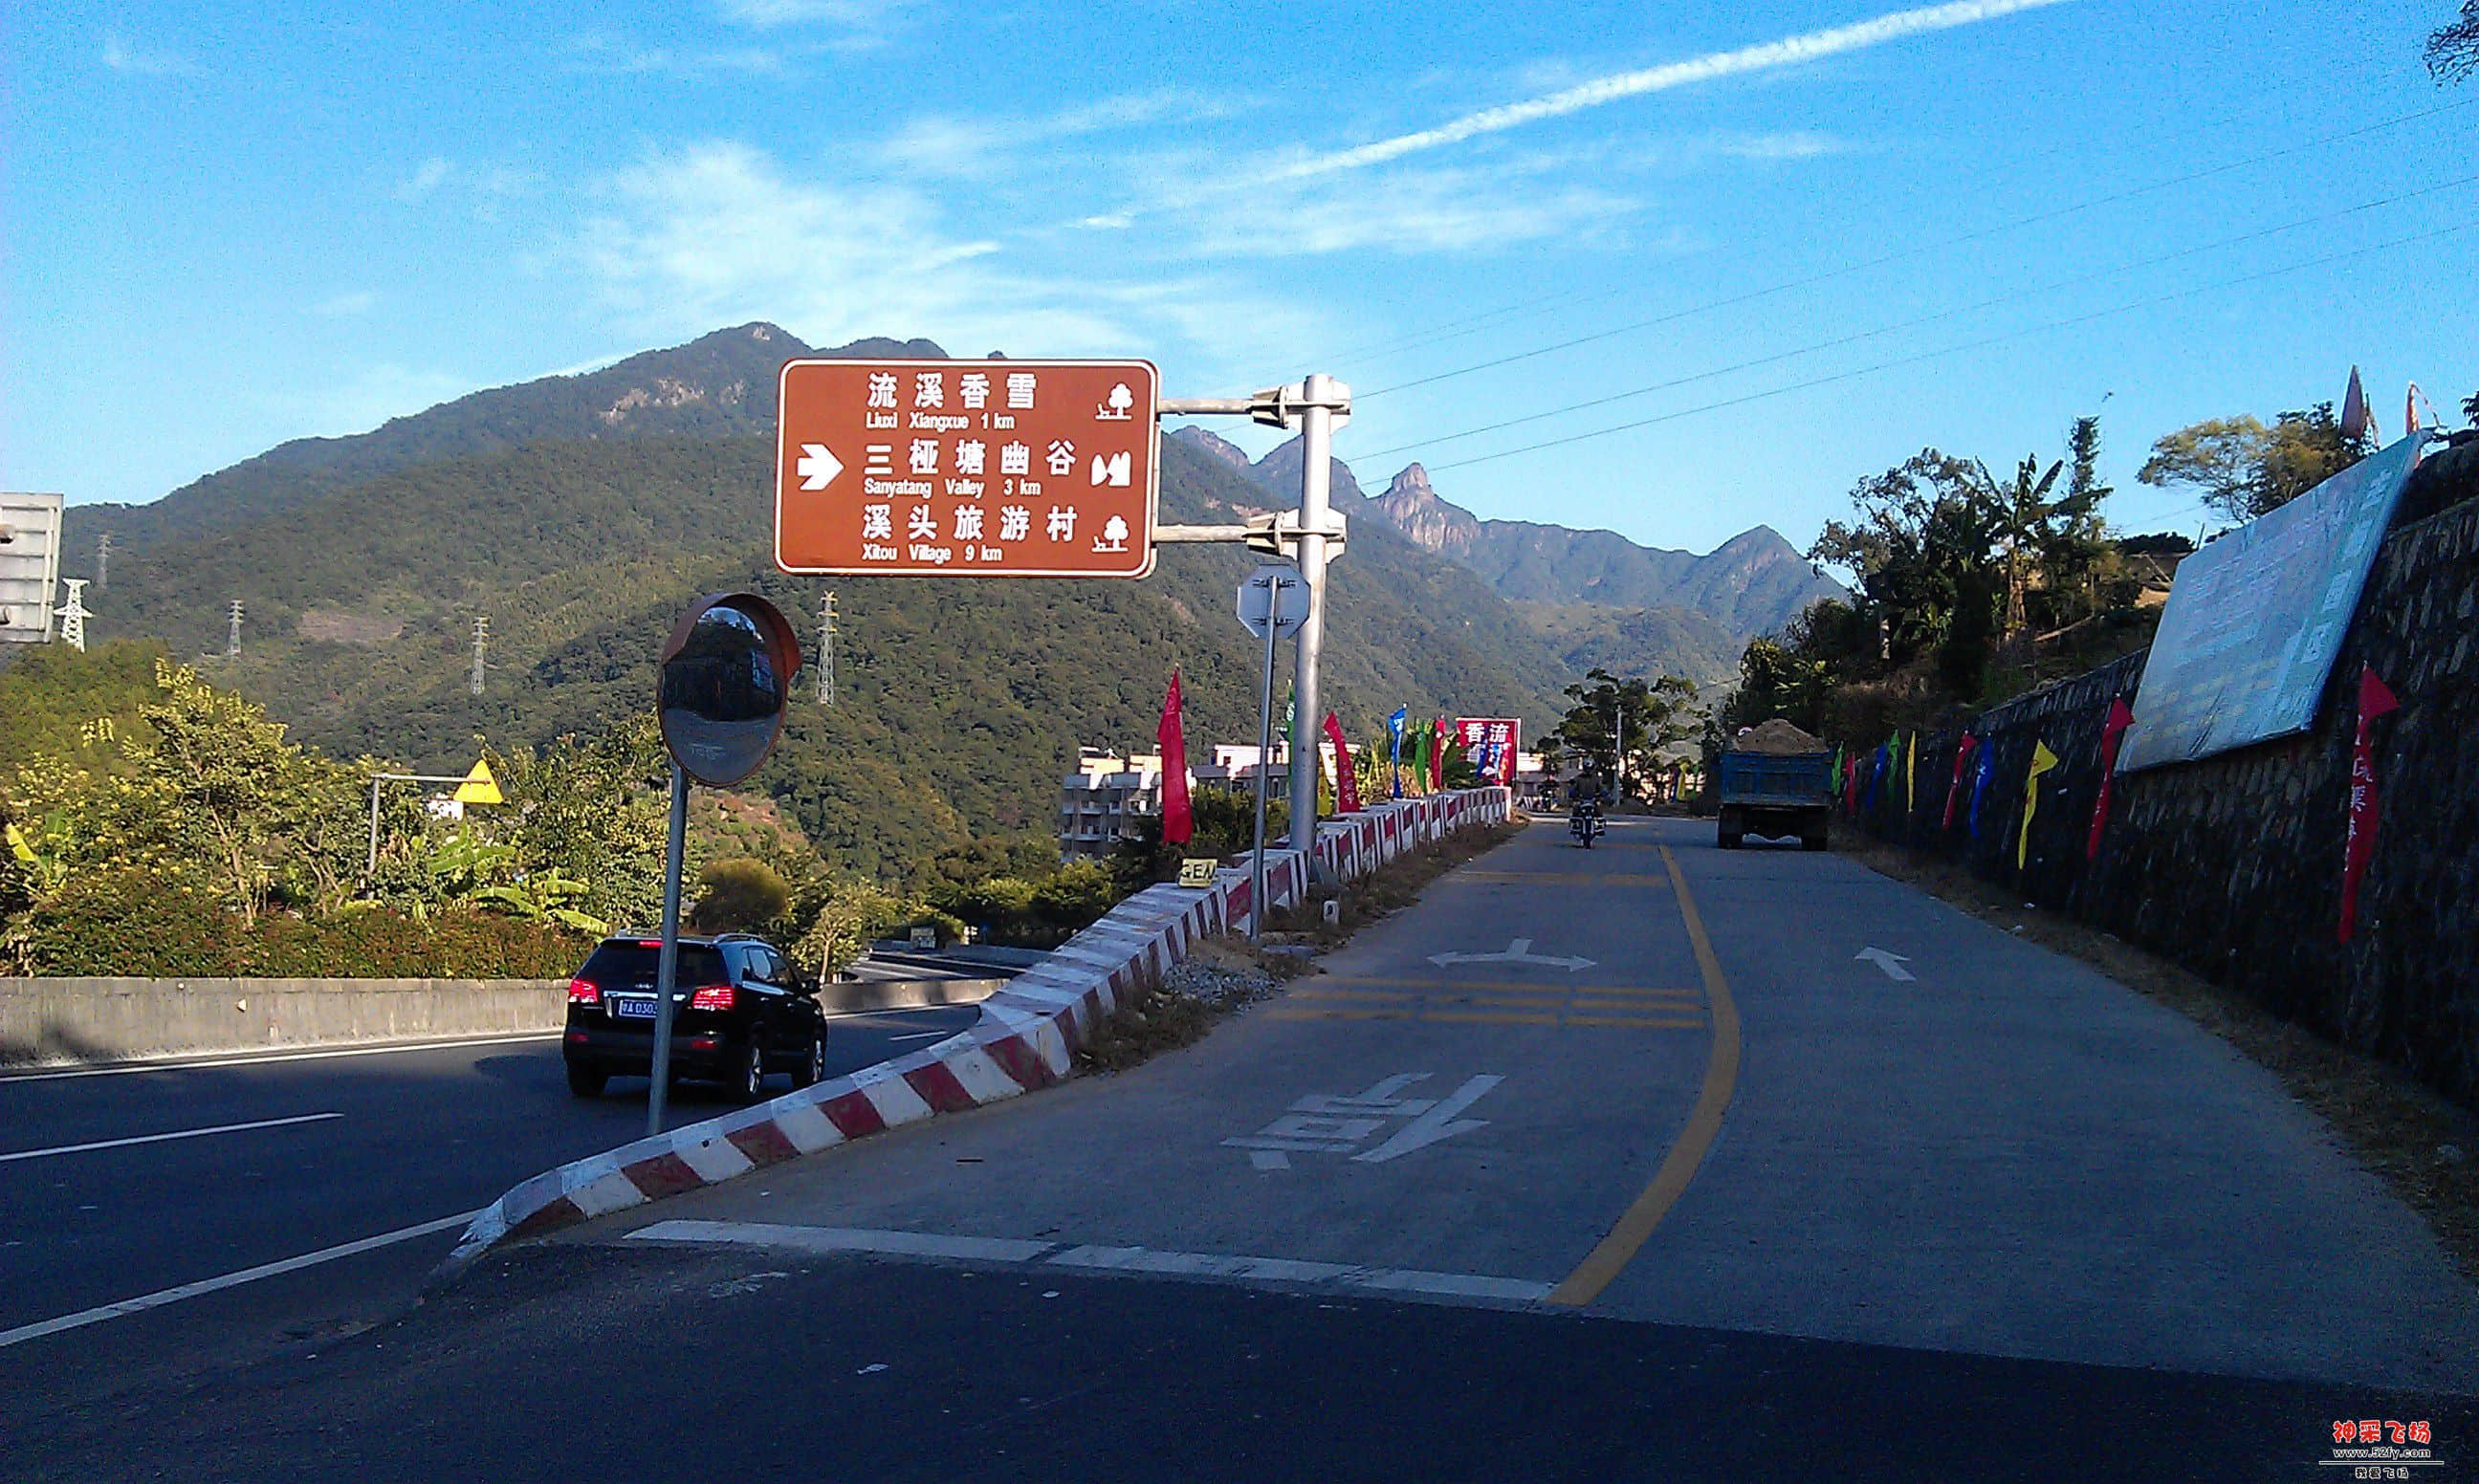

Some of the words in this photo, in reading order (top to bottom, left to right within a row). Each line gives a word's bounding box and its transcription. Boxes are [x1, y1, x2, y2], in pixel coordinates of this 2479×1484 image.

[867, 372, 1036, 408] 流溪香雪
[867, 412, 897, 428] Liuxi
[910, 412, 969, 432] Xiangxue
[981, 413, 988, 428] 1
[994, 413, 1014, 428] km
[865, 439, 1076, 474] 三桠塘幽谷
[865, 478, 932, 498] Sanyatang
[945, 479, 984, 498] Valley
[1004, 479, 1013, 495] 3
[1020, 478, 1041, 494] km
[863, 505, 1077, 541] 溪头旅游村
[862, 544, 897, 559] Xitou
[909, 544, 951, 564] Village
[965, 544, 975, 560] 9
[981, 545, 1002, 560] km
